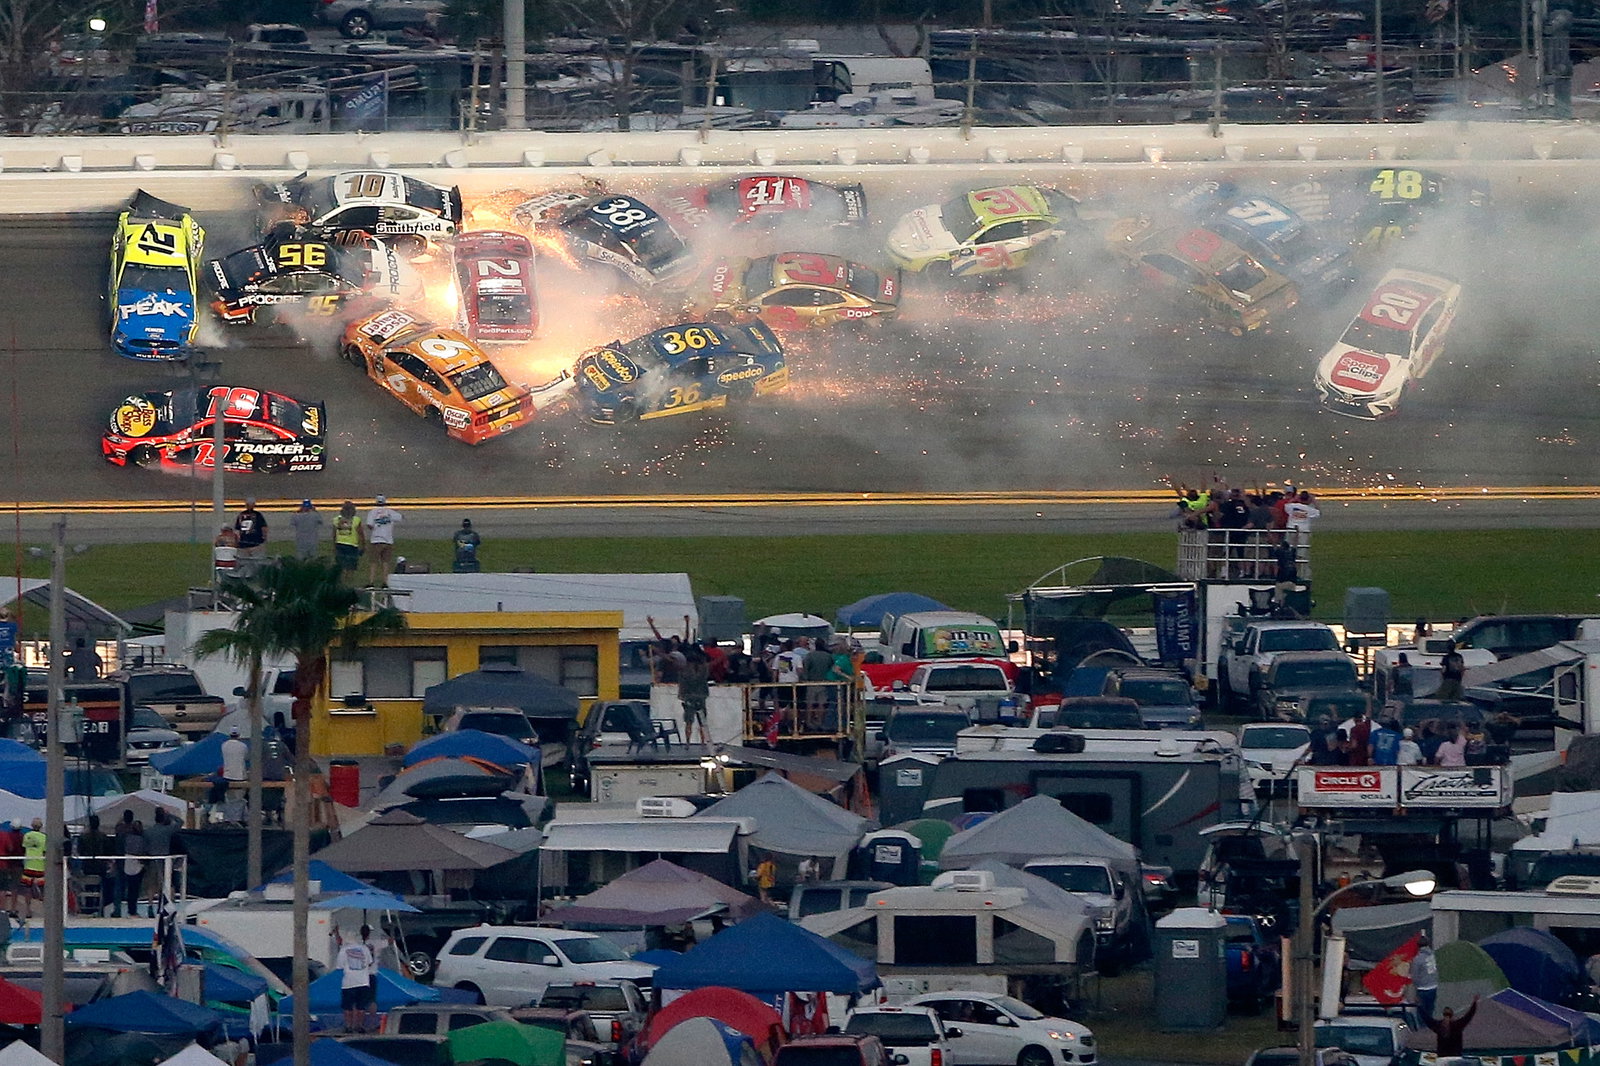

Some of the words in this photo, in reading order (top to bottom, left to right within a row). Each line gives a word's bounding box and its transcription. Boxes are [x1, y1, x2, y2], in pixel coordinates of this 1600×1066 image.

[344, 174, 385, 199] 10
[746, 179, 785, 206] 41
[1370, 169, 1422, 199] 48
[592, 198, 647, 226] 38
[974, 188, 1034, 215] 31
[334, 229, 363, 247] 10
[376, 222, 442, 234] Smithfield
[137, 223, 175, 256] 12
[211, 259, 230, 290] PROCORE
[712, 266, 728, 292] DOW
[777, 252, 836, 285] 3
[884, 279, 894, 296] DOW
[119, 301, 188, 319] PEAK
[238, 294, 304, 308] PROCORE
[307, 295, 341, 316] 95
[1371, 292, 1420, 325] 20
[367, 311, 402, 334] Mayer
[847, 309, 873, 318] DOW
[419, 337, 474, 359] 6
[662, 327, 706, 354] 36
[601, 349, 633, 382] speedco
[720, 367, 762, 382] speedco
[1339, 357, 1379, 372] Sport
[1349, 366, 1381, 380] Clips
[387, 373, 407, 393] 6
[206, 386, 259, 419] 19
[664, 383, 702, 408] 36
[120, 411, 134, 432] Shops
[133, 408, 143, 423] Pro
[142, 409, 153, 426] Bass
[446, 409, 466, 419] Oscar
[234, 443, 304, 454] TRACKER
[289, 464, 323, 472] BOATS
[1176, 603, 1190, 651] TRUMP
[1319, 776, 1358, 785] CIRCLE
